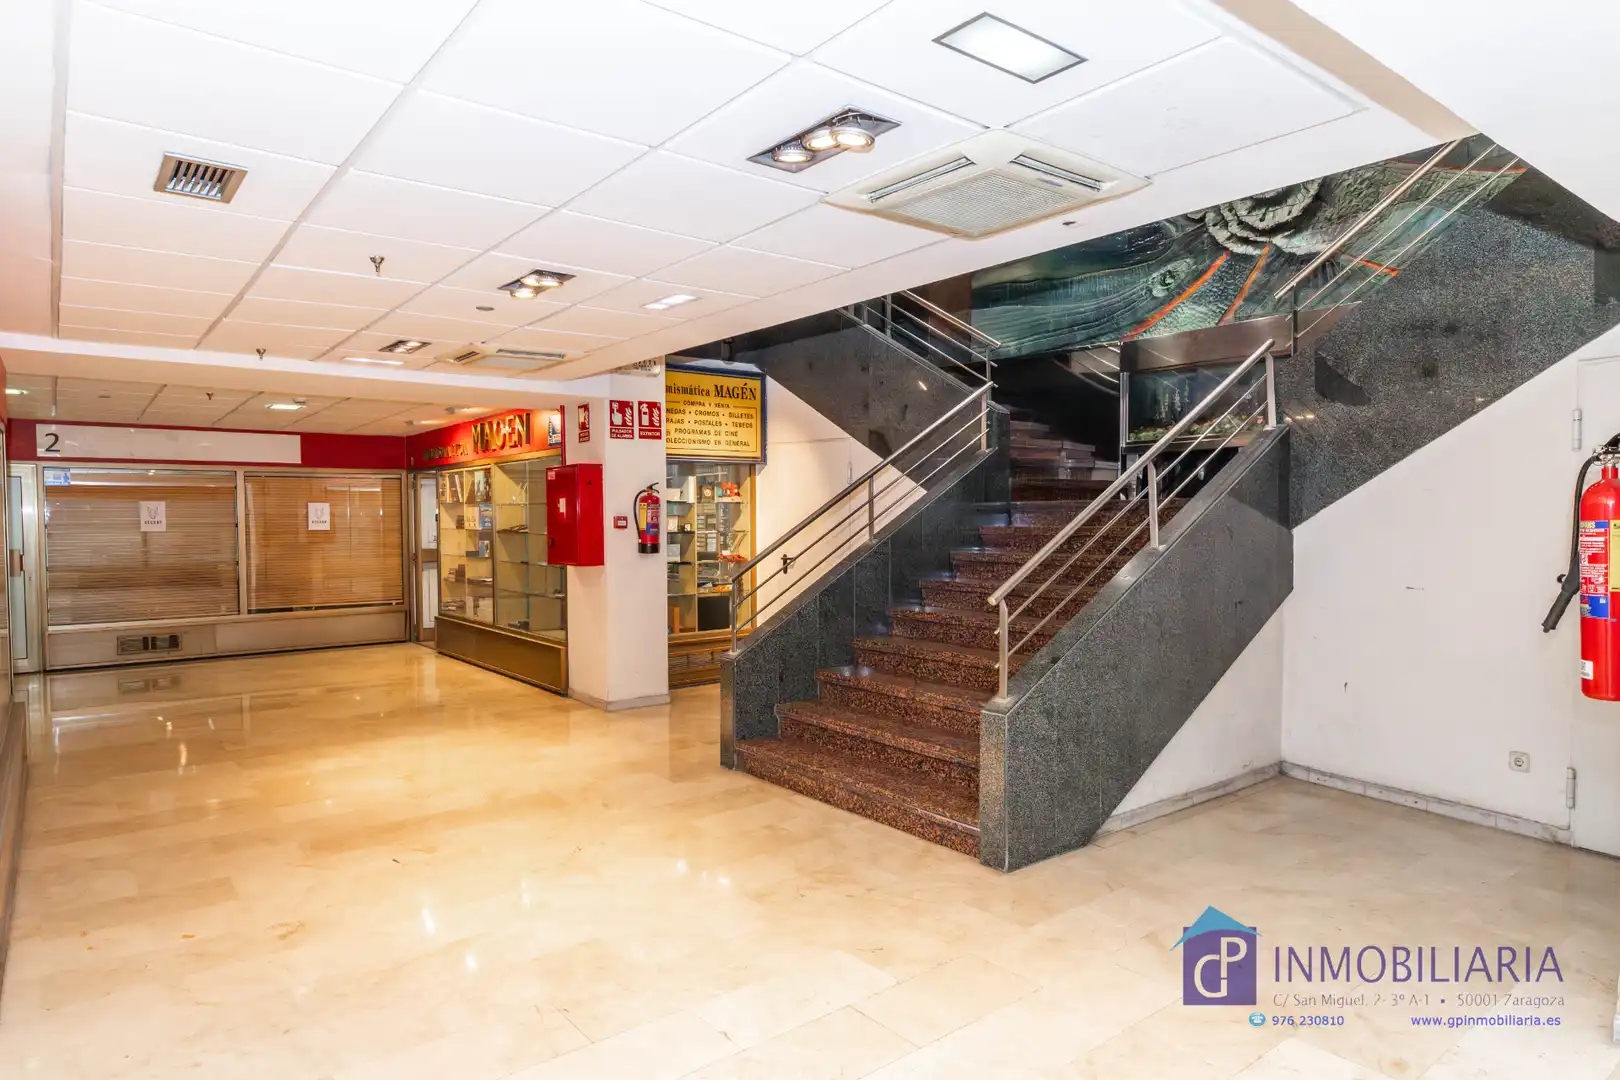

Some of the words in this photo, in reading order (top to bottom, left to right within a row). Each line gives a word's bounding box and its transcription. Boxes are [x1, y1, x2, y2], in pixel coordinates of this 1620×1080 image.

[713, 382, 757, 401] MAGÉN
[693, 419, 723, 427] POSTALES
[731, 421, 753, 429] TEBEOS
[674, 428, 712, 436] PROGRAMAS
[45, 432, 61, 452] 2
[666, 438, 711, 446] OLECCIONISMO
